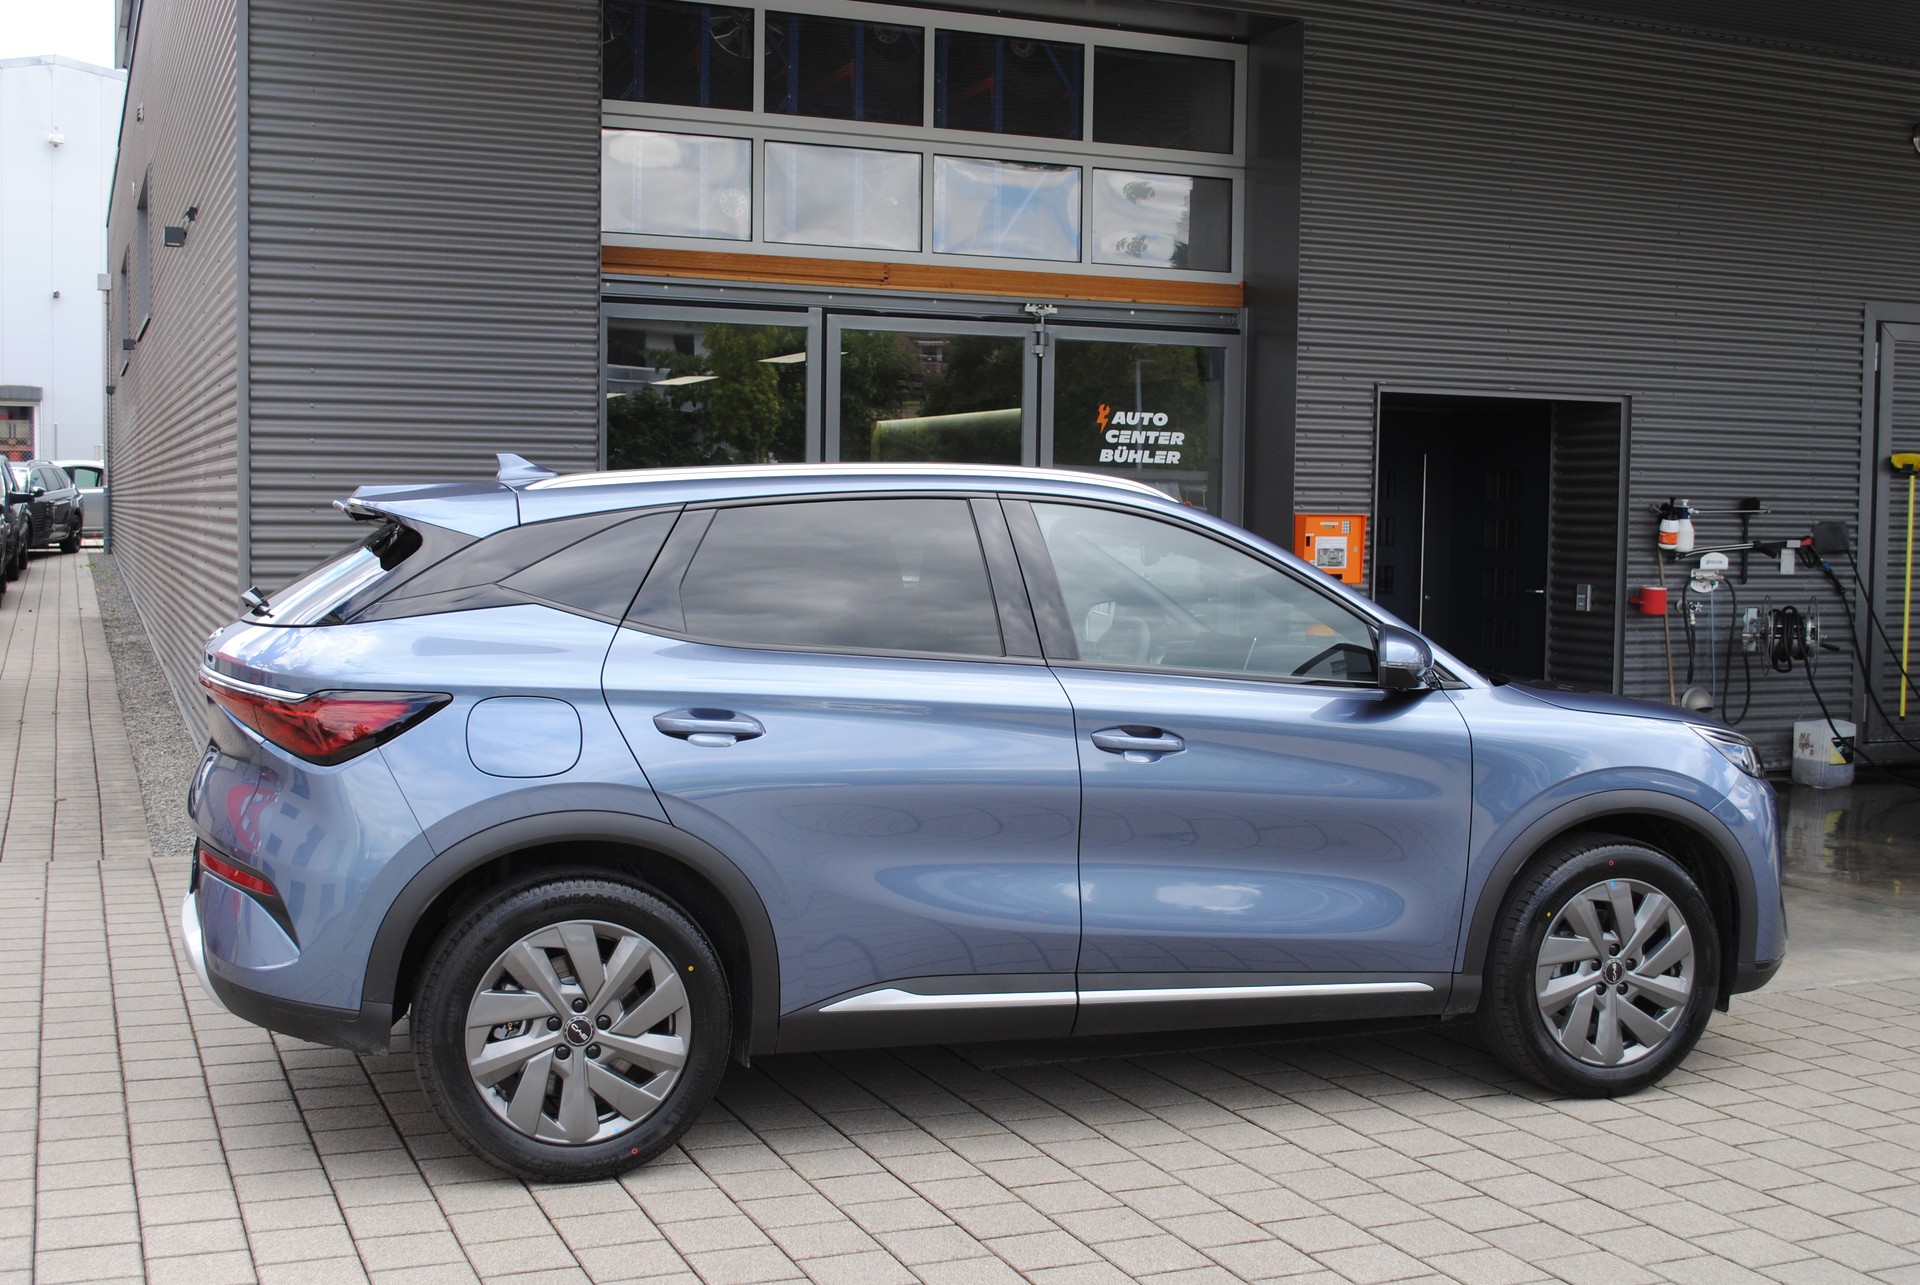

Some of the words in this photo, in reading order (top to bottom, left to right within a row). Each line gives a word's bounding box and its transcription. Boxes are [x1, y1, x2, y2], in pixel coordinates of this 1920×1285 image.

[1111, 411, 1168, 426] AUTO
[1105, 429, 1185, 445] CENTER
[1099, 446, 1181, 464] BÜHLER
[571, 1023, 588, 1040] BYD
